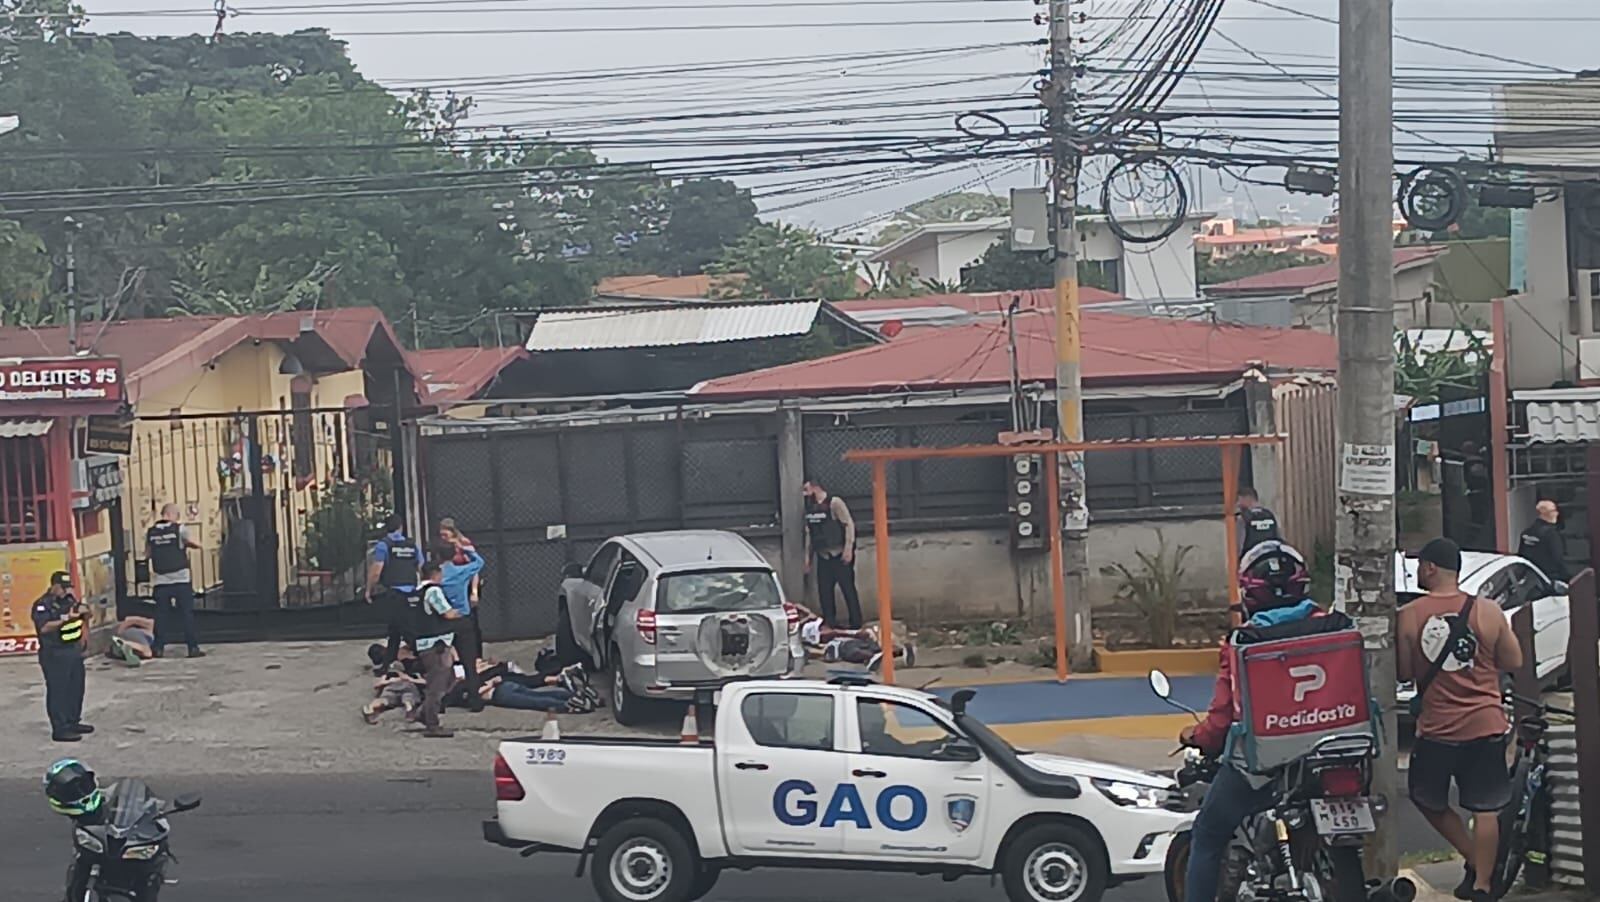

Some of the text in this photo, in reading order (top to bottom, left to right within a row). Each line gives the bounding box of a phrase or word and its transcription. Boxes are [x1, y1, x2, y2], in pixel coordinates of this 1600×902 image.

[95, 368, 116, 383] #5
[1265, 704, 1356, 730] PedidosYa
[773, 779, 928, 832] GAO
